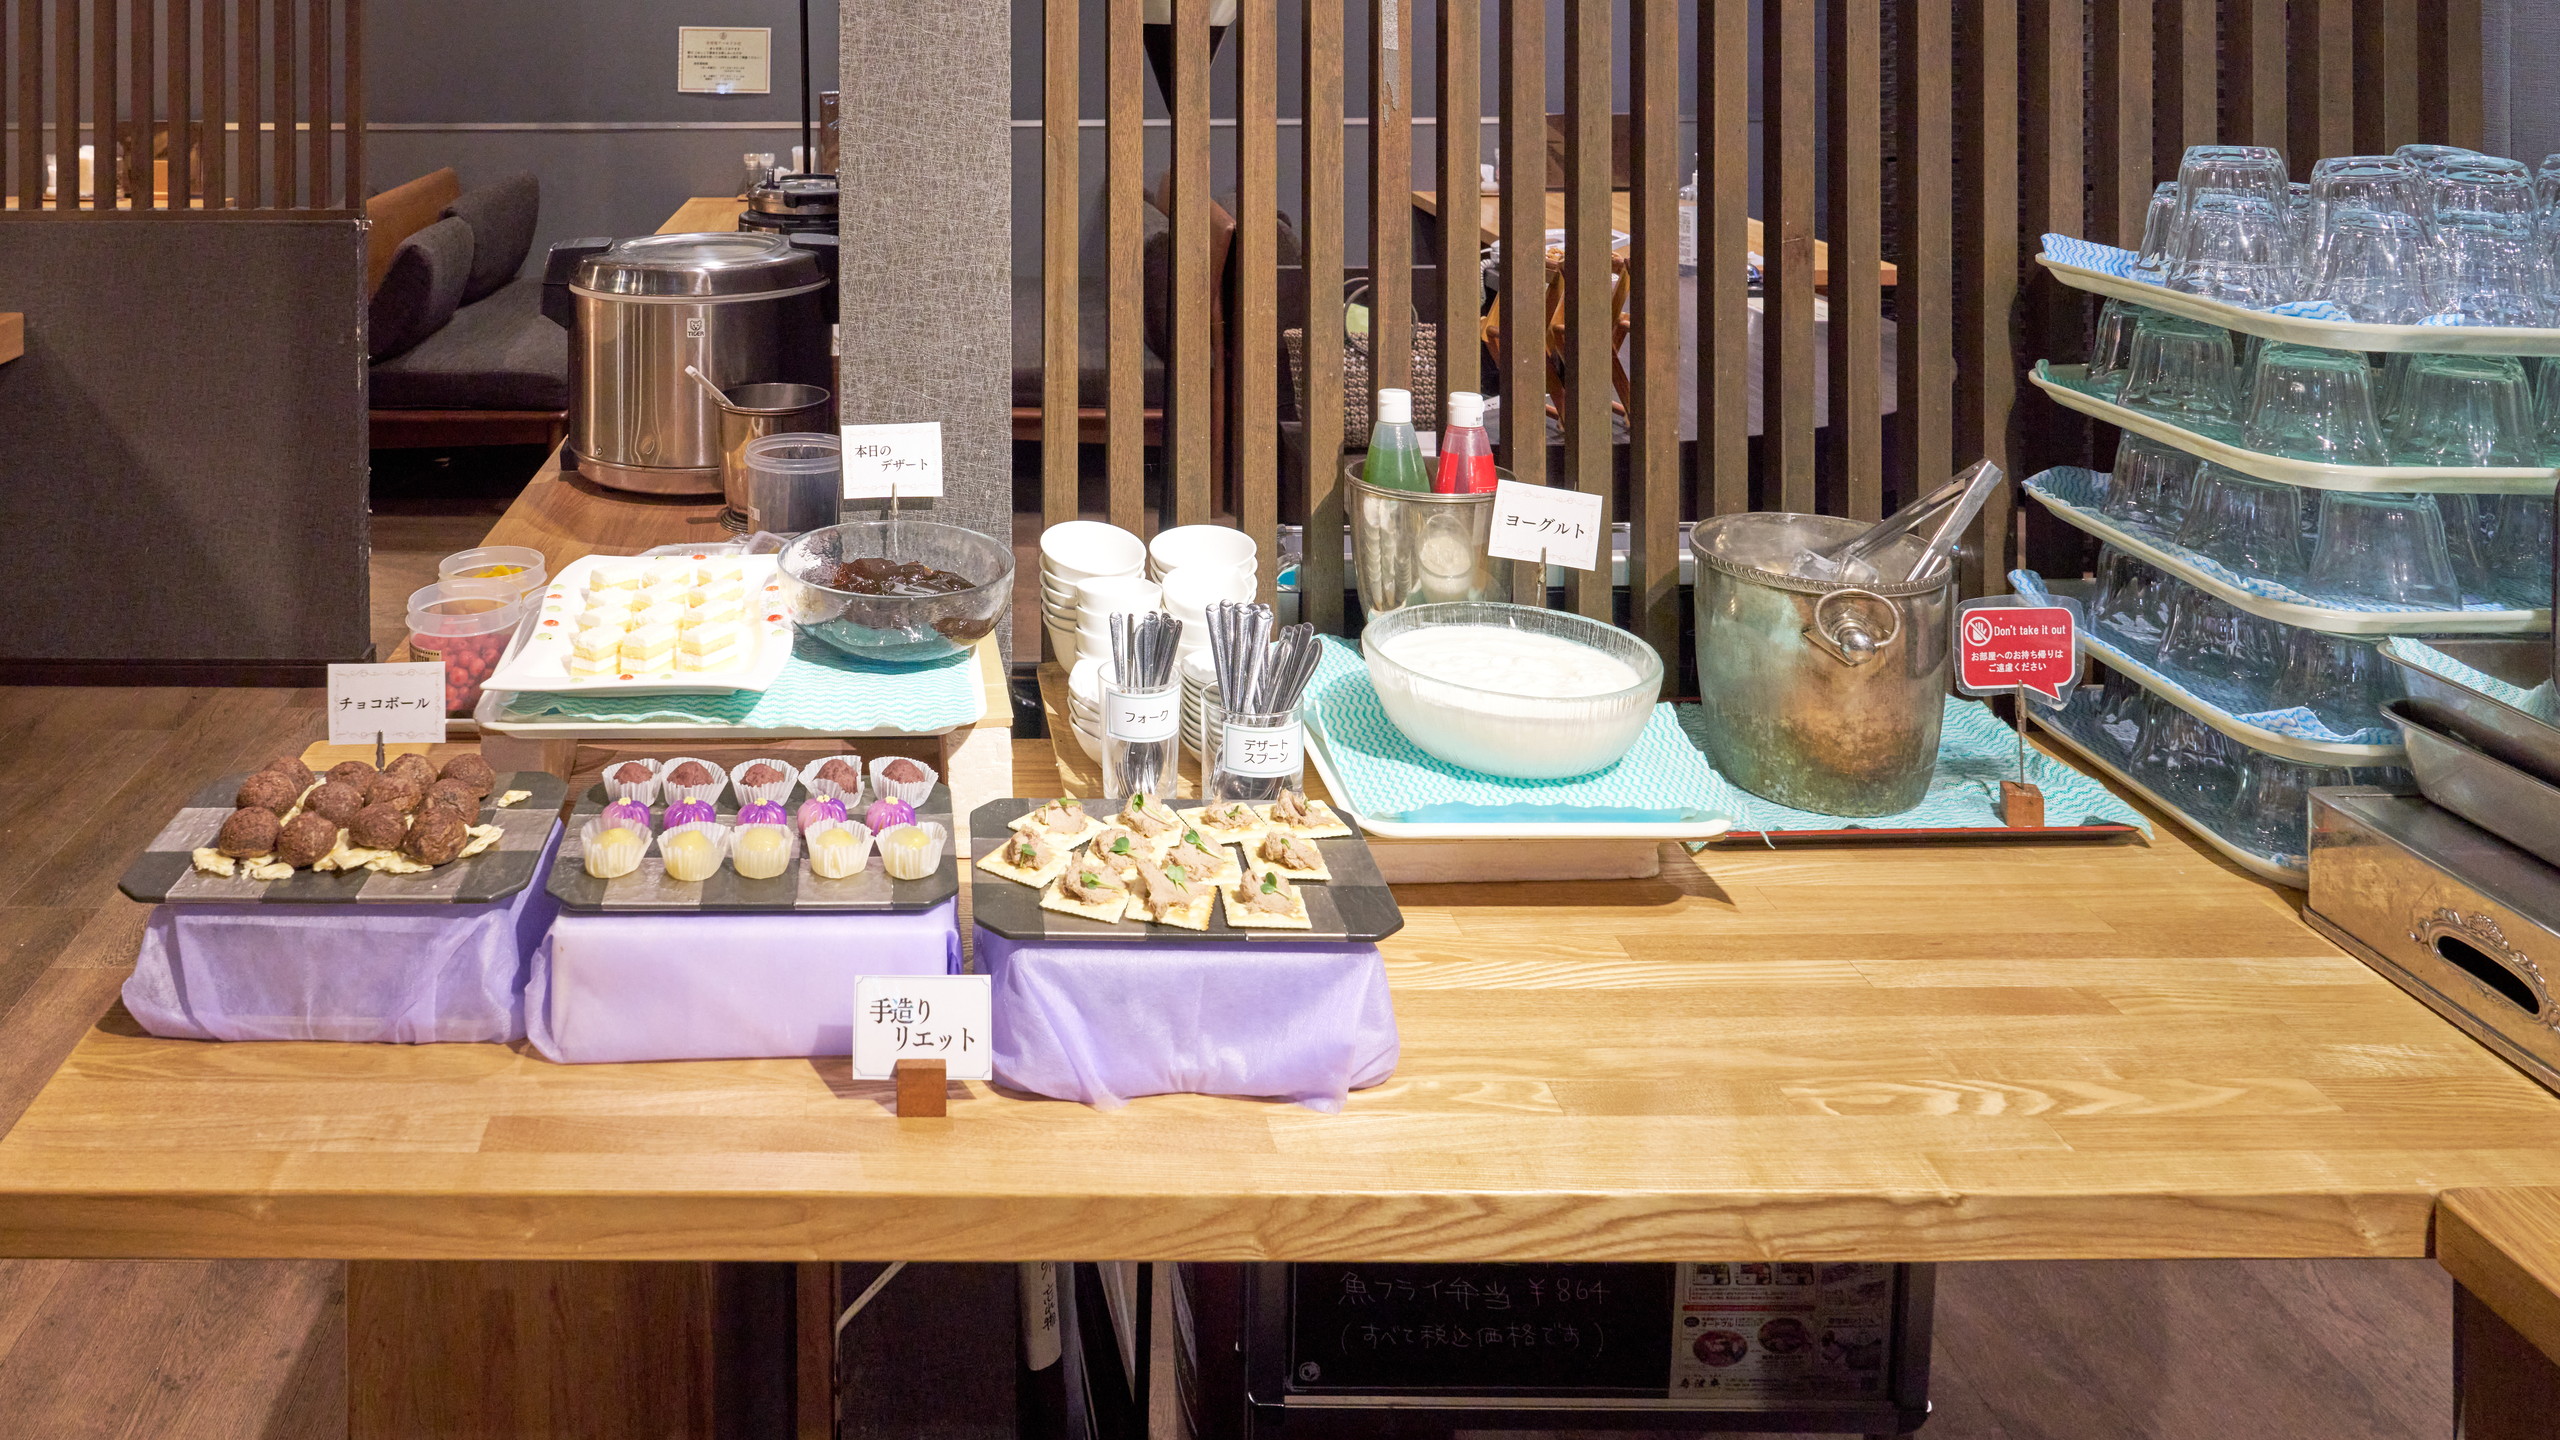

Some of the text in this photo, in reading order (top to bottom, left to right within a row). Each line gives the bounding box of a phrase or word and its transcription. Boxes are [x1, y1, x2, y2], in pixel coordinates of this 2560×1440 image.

[855, 445, 891, 458] 本日の
[881, 459, 928, 472] デザート
[1506, 514, 1584, 539] ヨーグルト
[1994, 625, 2066, 636] Don't take it out
[1971, 649, 2063, 661] お部屋へのお持ち帰りは
[1988, 662, 2047, 672] ご遠慮ください
[340, 696, 431, 711] チョコボール
[1125, 710, 1169, 724] フォーク
[1245, 739, 1288, 750] デザート
[1244, 752, 1289, 764] スプーン
[869, 997, 931, 1024] 手造り
[896, 1026, 975, 1052] リエット
[1338, 1271, 1512, 1310] 魚フライ弁当
